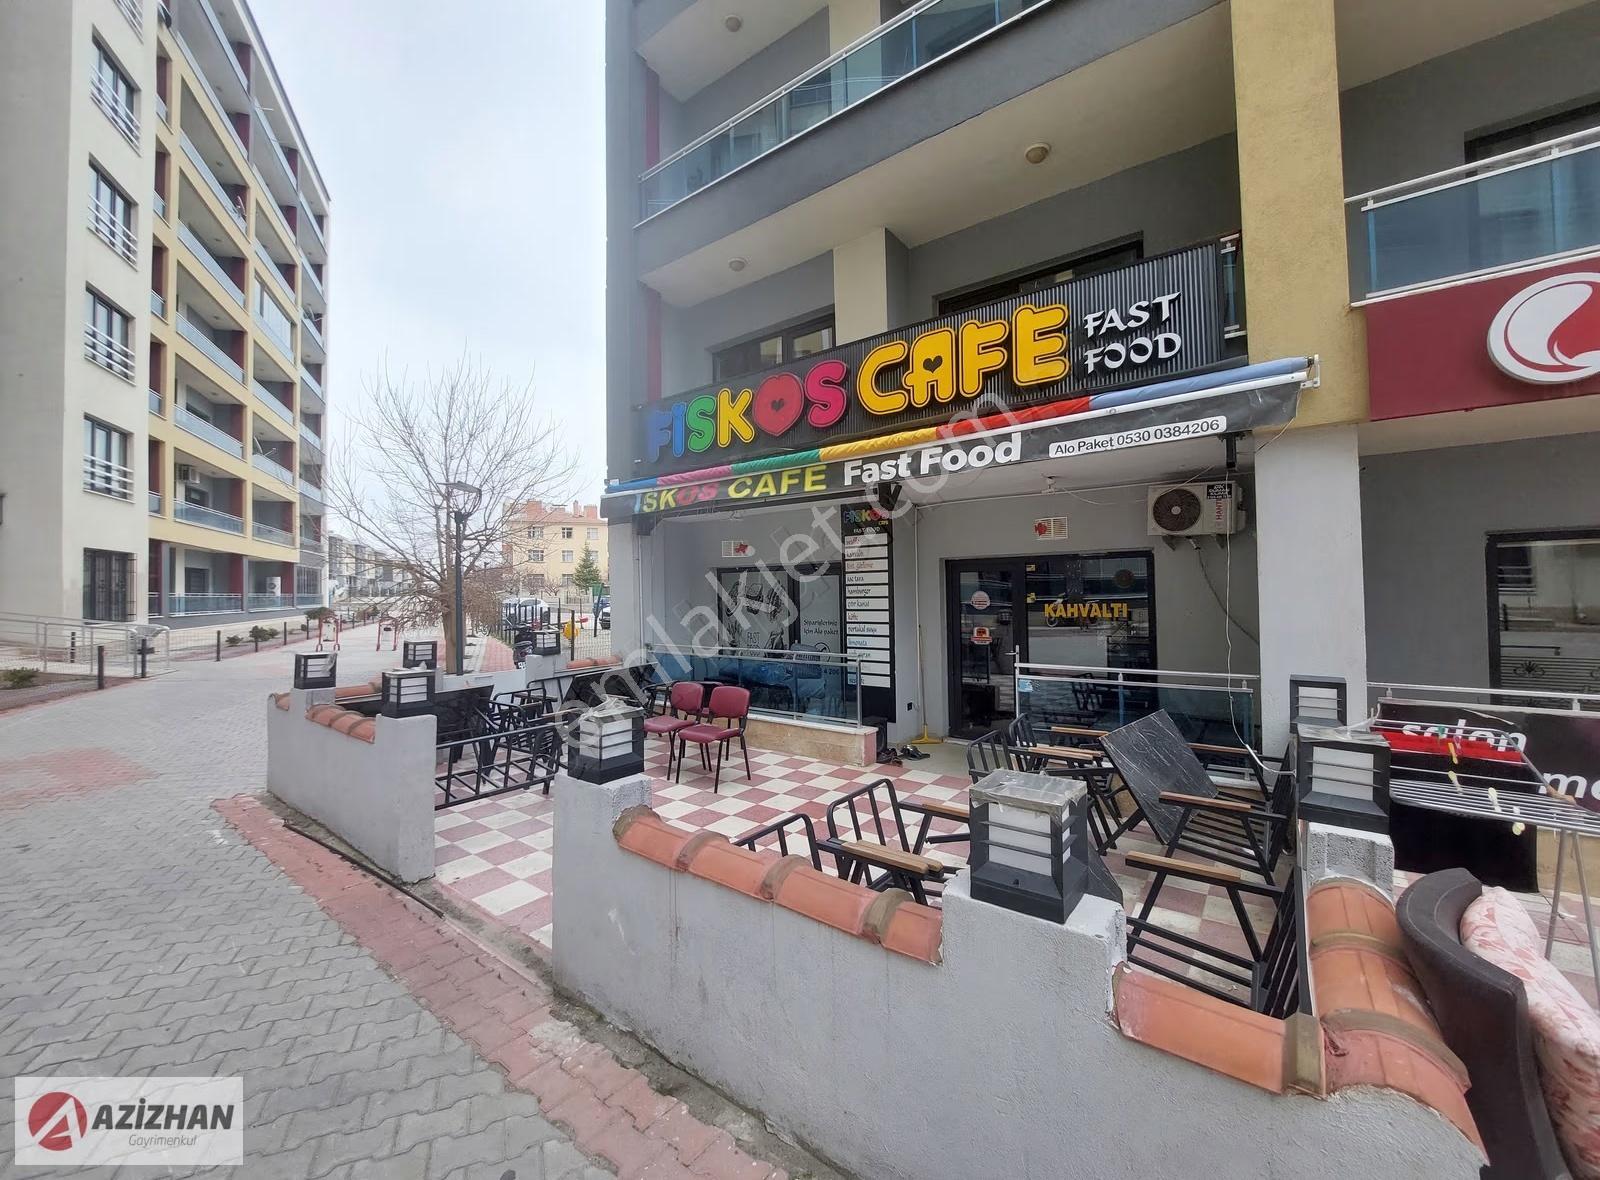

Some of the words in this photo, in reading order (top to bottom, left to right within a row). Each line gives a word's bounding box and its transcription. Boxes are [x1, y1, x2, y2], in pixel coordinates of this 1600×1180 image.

[1084, 292, 1181, 338] FAST
[856, 303, 1070, 415] CAFE
[1084, 332, 1182, 374] FOOD
[1054, 443, 1075, 456] Alo
[1077, 436, 1114, 453] Paket
[1116, 430, 1151, 447] 0530
[1154, 419, 1220, 440] 0384206
[727, 464, 827, 499] CAFE
[843, 453, 912, 487] Fast
[920, 431, 1022, 472] Food
[1044, 602, 1128, 618] KAHVALTI
